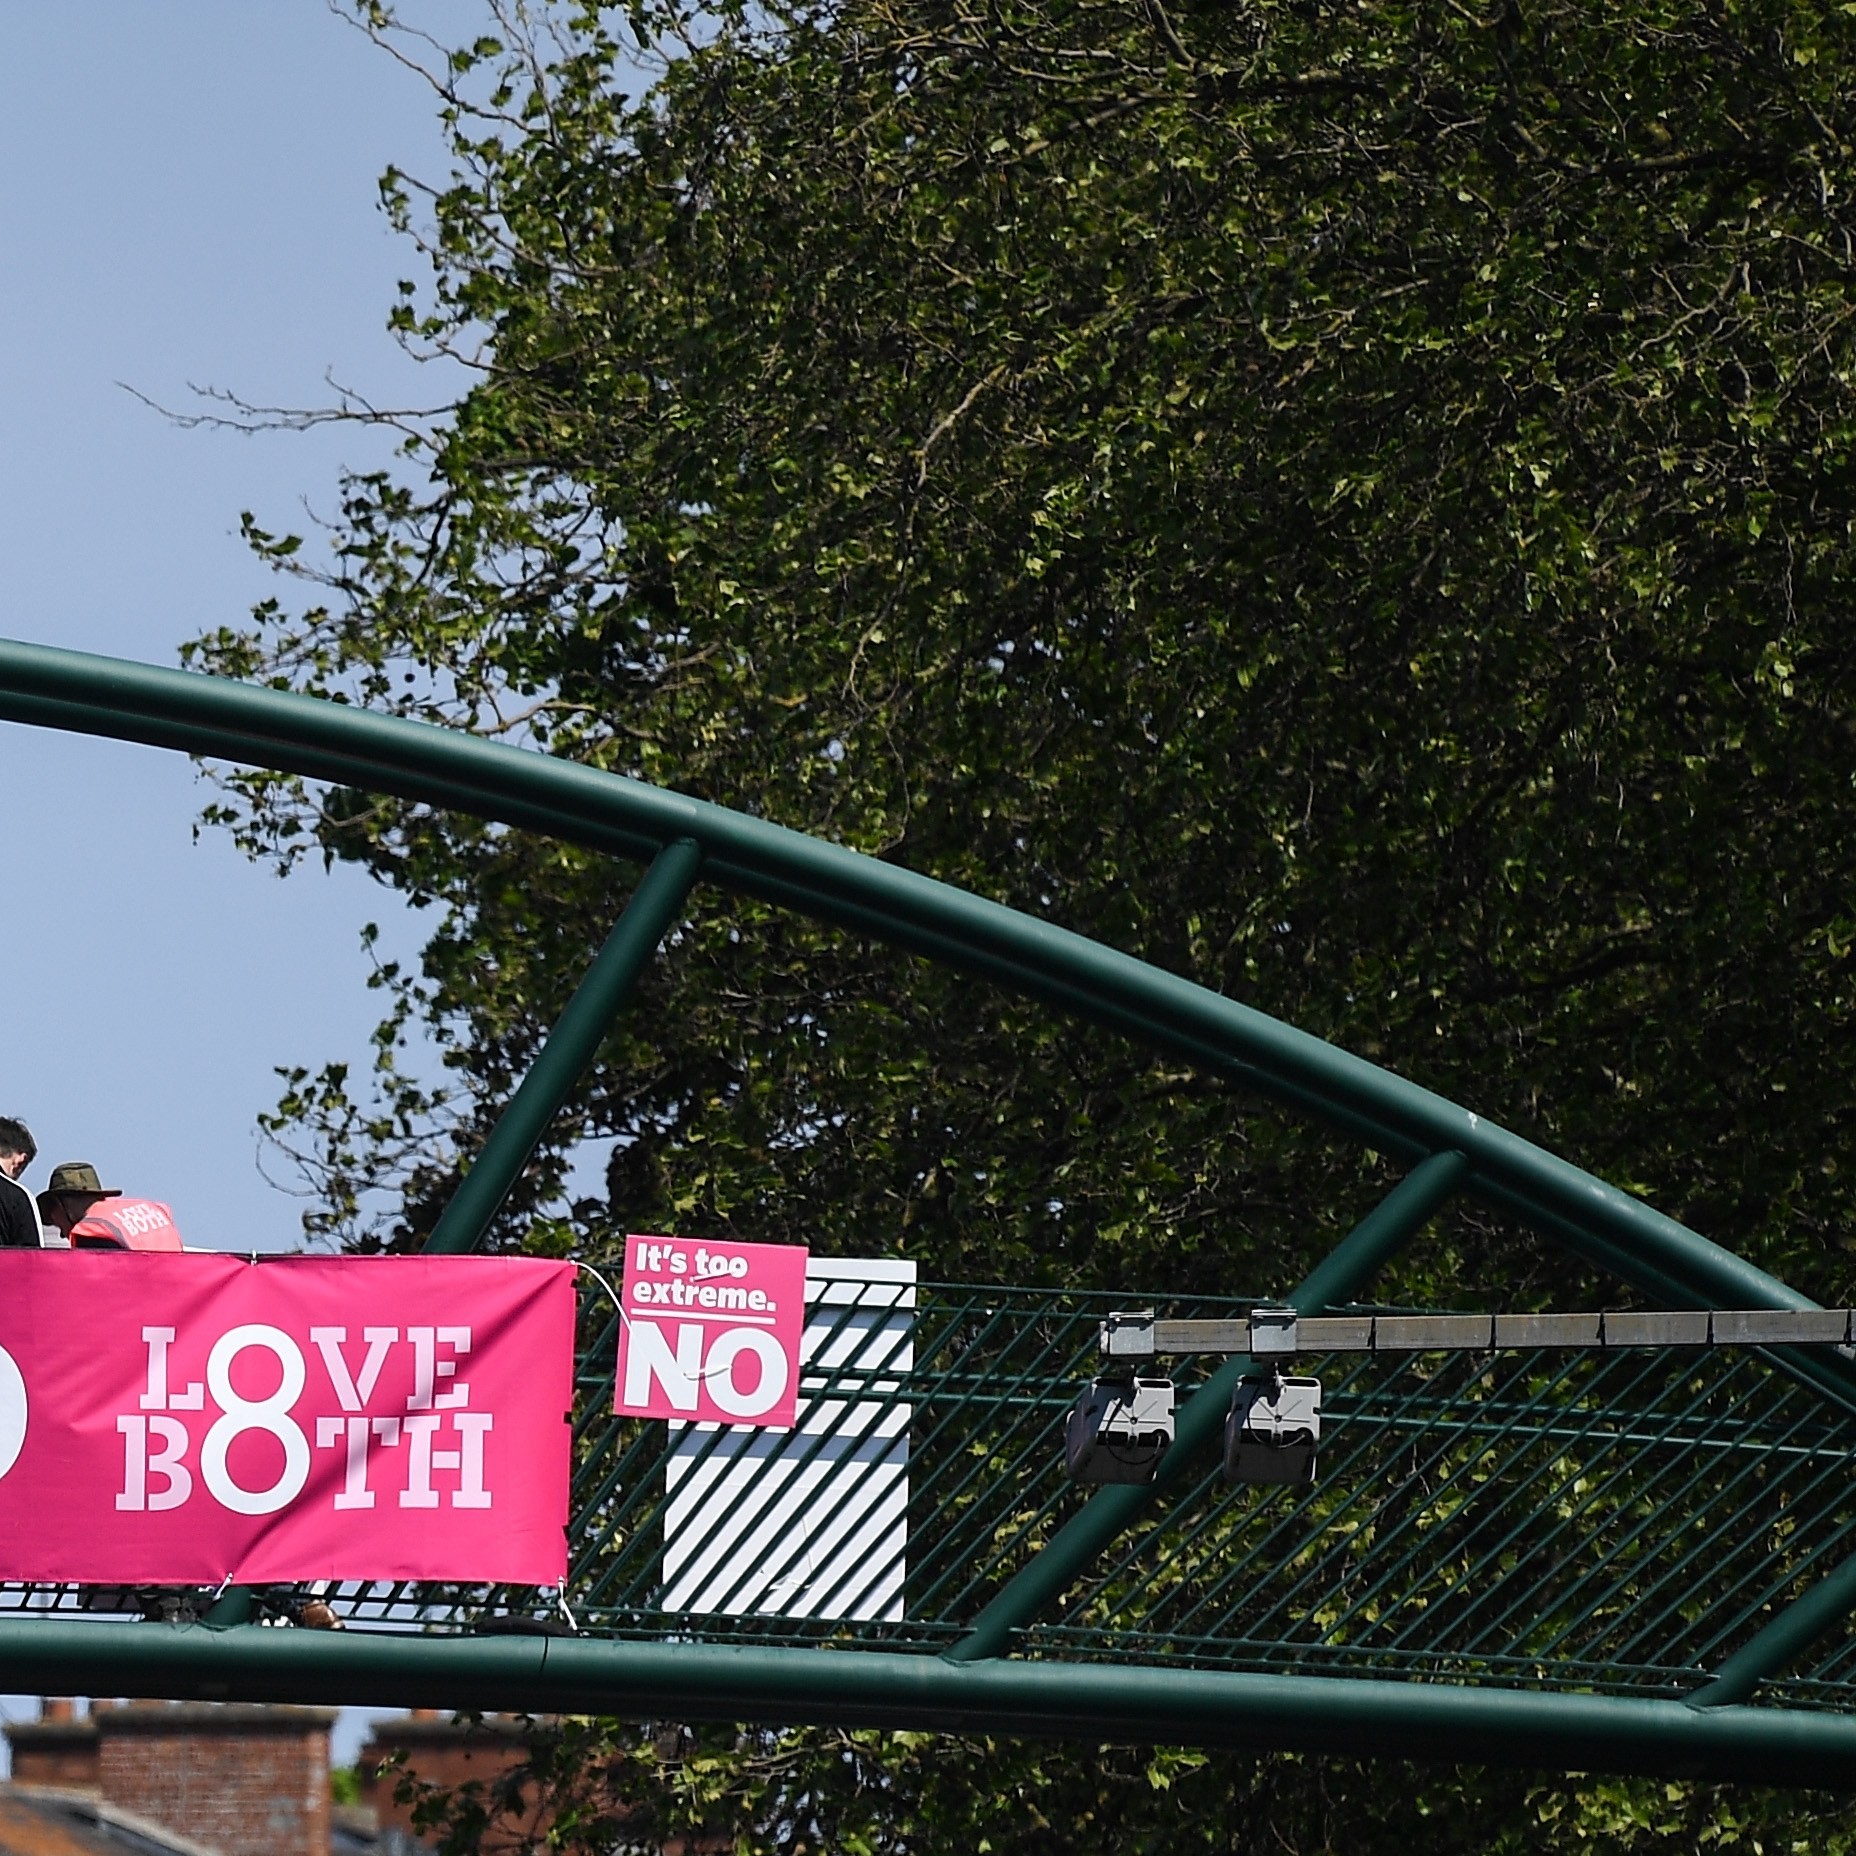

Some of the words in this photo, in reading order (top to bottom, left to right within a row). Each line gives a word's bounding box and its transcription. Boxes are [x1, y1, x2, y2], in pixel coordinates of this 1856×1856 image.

[122, 1211, 169, 1237] BOTH
[635, 1243, 687, 1274] It's
[694, 1247, 748, 1279] too
[633, 1280, 777, 1312] extreme.
[140, 1323, 473, 1412] LOVE
[623, 1320, 789, 1418] NO
[115, 1410, 494, 1516] BOTH
